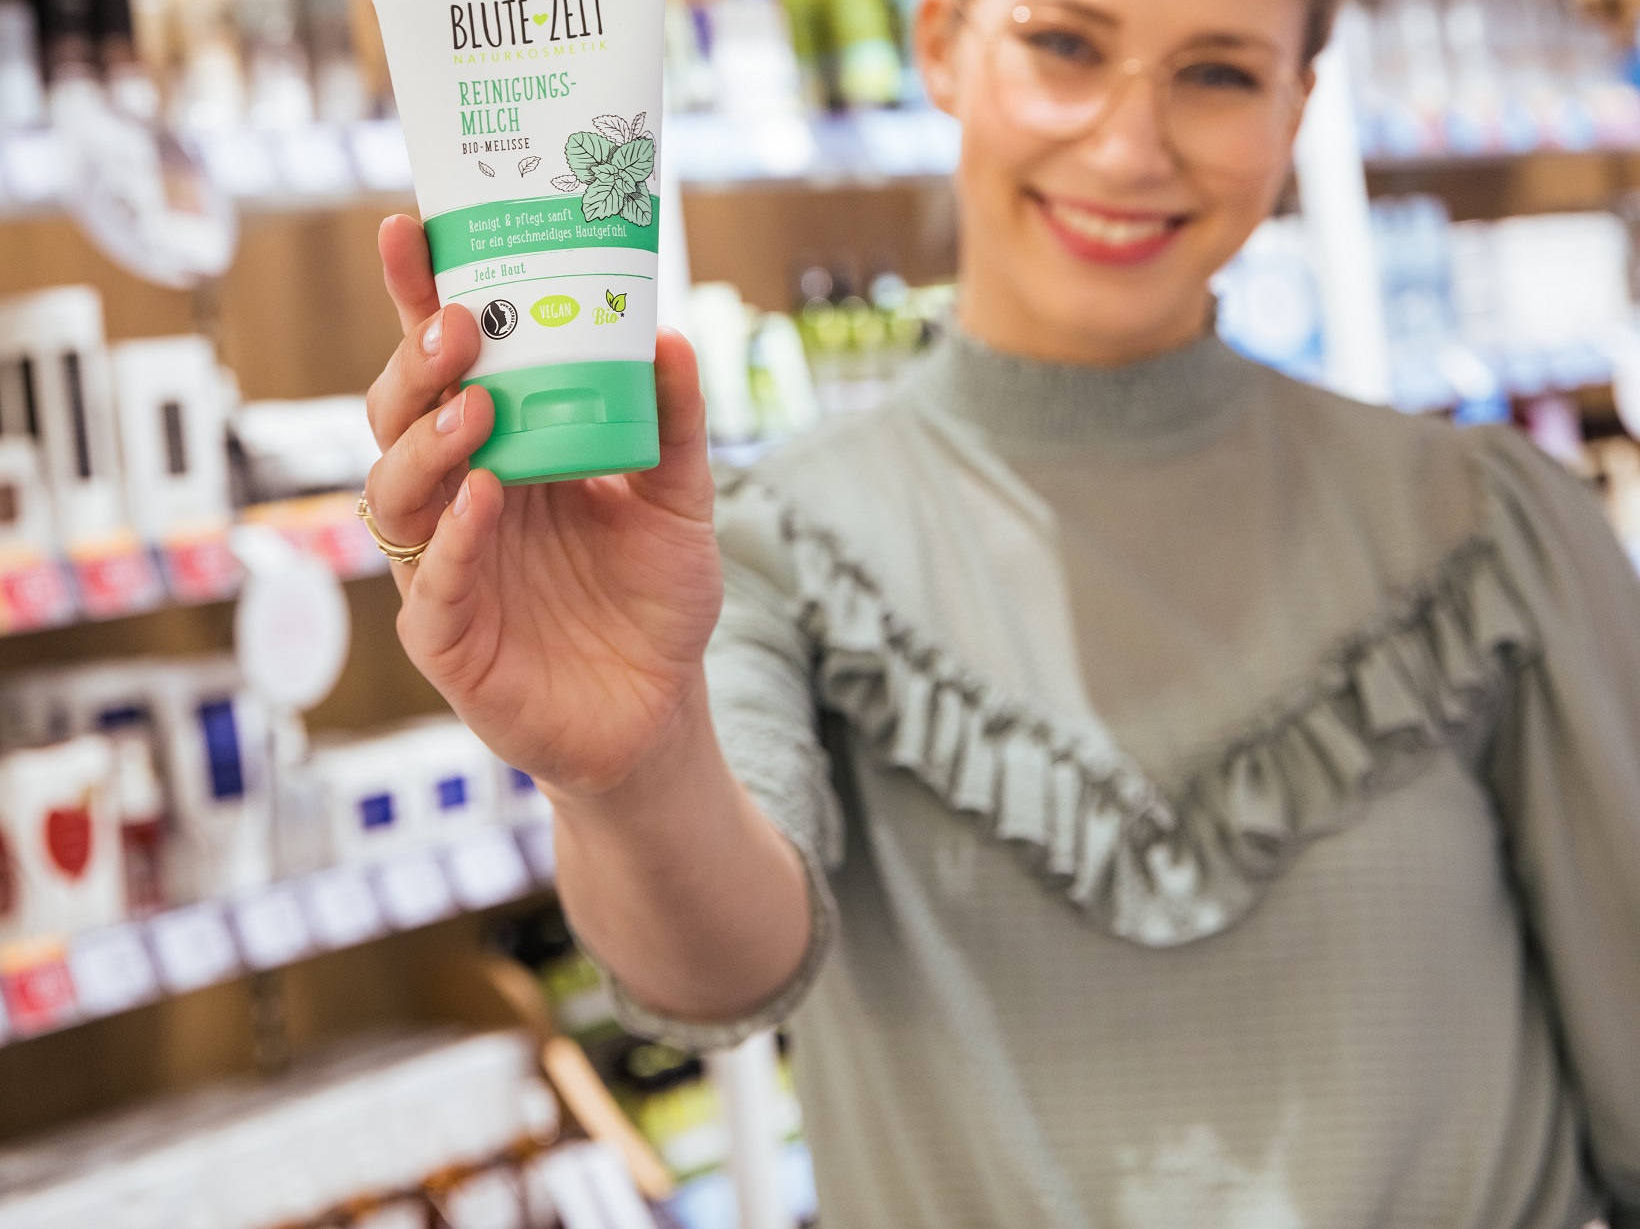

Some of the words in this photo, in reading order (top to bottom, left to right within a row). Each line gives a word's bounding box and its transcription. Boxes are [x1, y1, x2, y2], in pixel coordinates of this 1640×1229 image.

[453, 40, 608, 65] NATURKOSMETIK
[458, 72, 577, 106] REINIGUNGS-
[460, 107, 521, 136] MILCH
[462, 137, 530, 155] BIO-MELISSE
[469, 217, 501, 233] Reinigt
[505, 213, 511, 227] &
[516, 212, 543, 228] pflegt
[548, 209, 573, 222] sanft
[490, 235, 504, 248] ein
[507, 227, 573, 247] geschmeidiges
[474, 267, 496, 282] Jede
[501, 262, 526, 277] Haut
[539, 302, 572, 319] VEGAN
